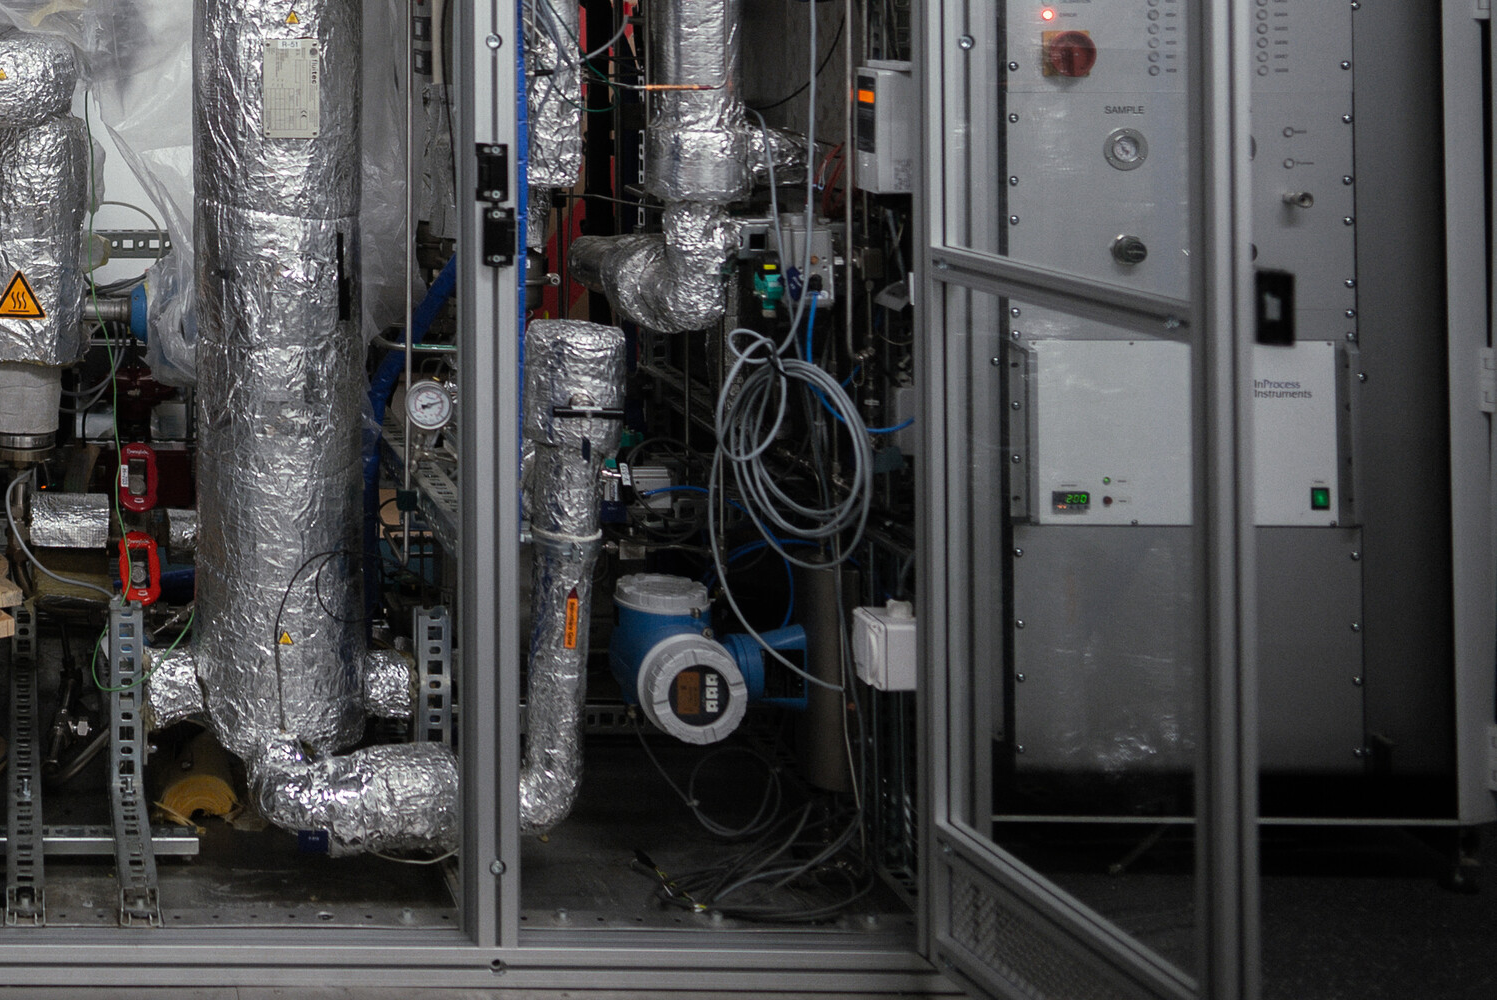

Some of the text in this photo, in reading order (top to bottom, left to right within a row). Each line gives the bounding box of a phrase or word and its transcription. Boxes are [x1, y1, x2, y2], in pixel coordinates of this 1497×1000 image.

[1104, 105, 1145, 114] SAMPLE
[1254, 379, 1301, 389] InProcess
[1254, 389, 1313, 398] Instruments
